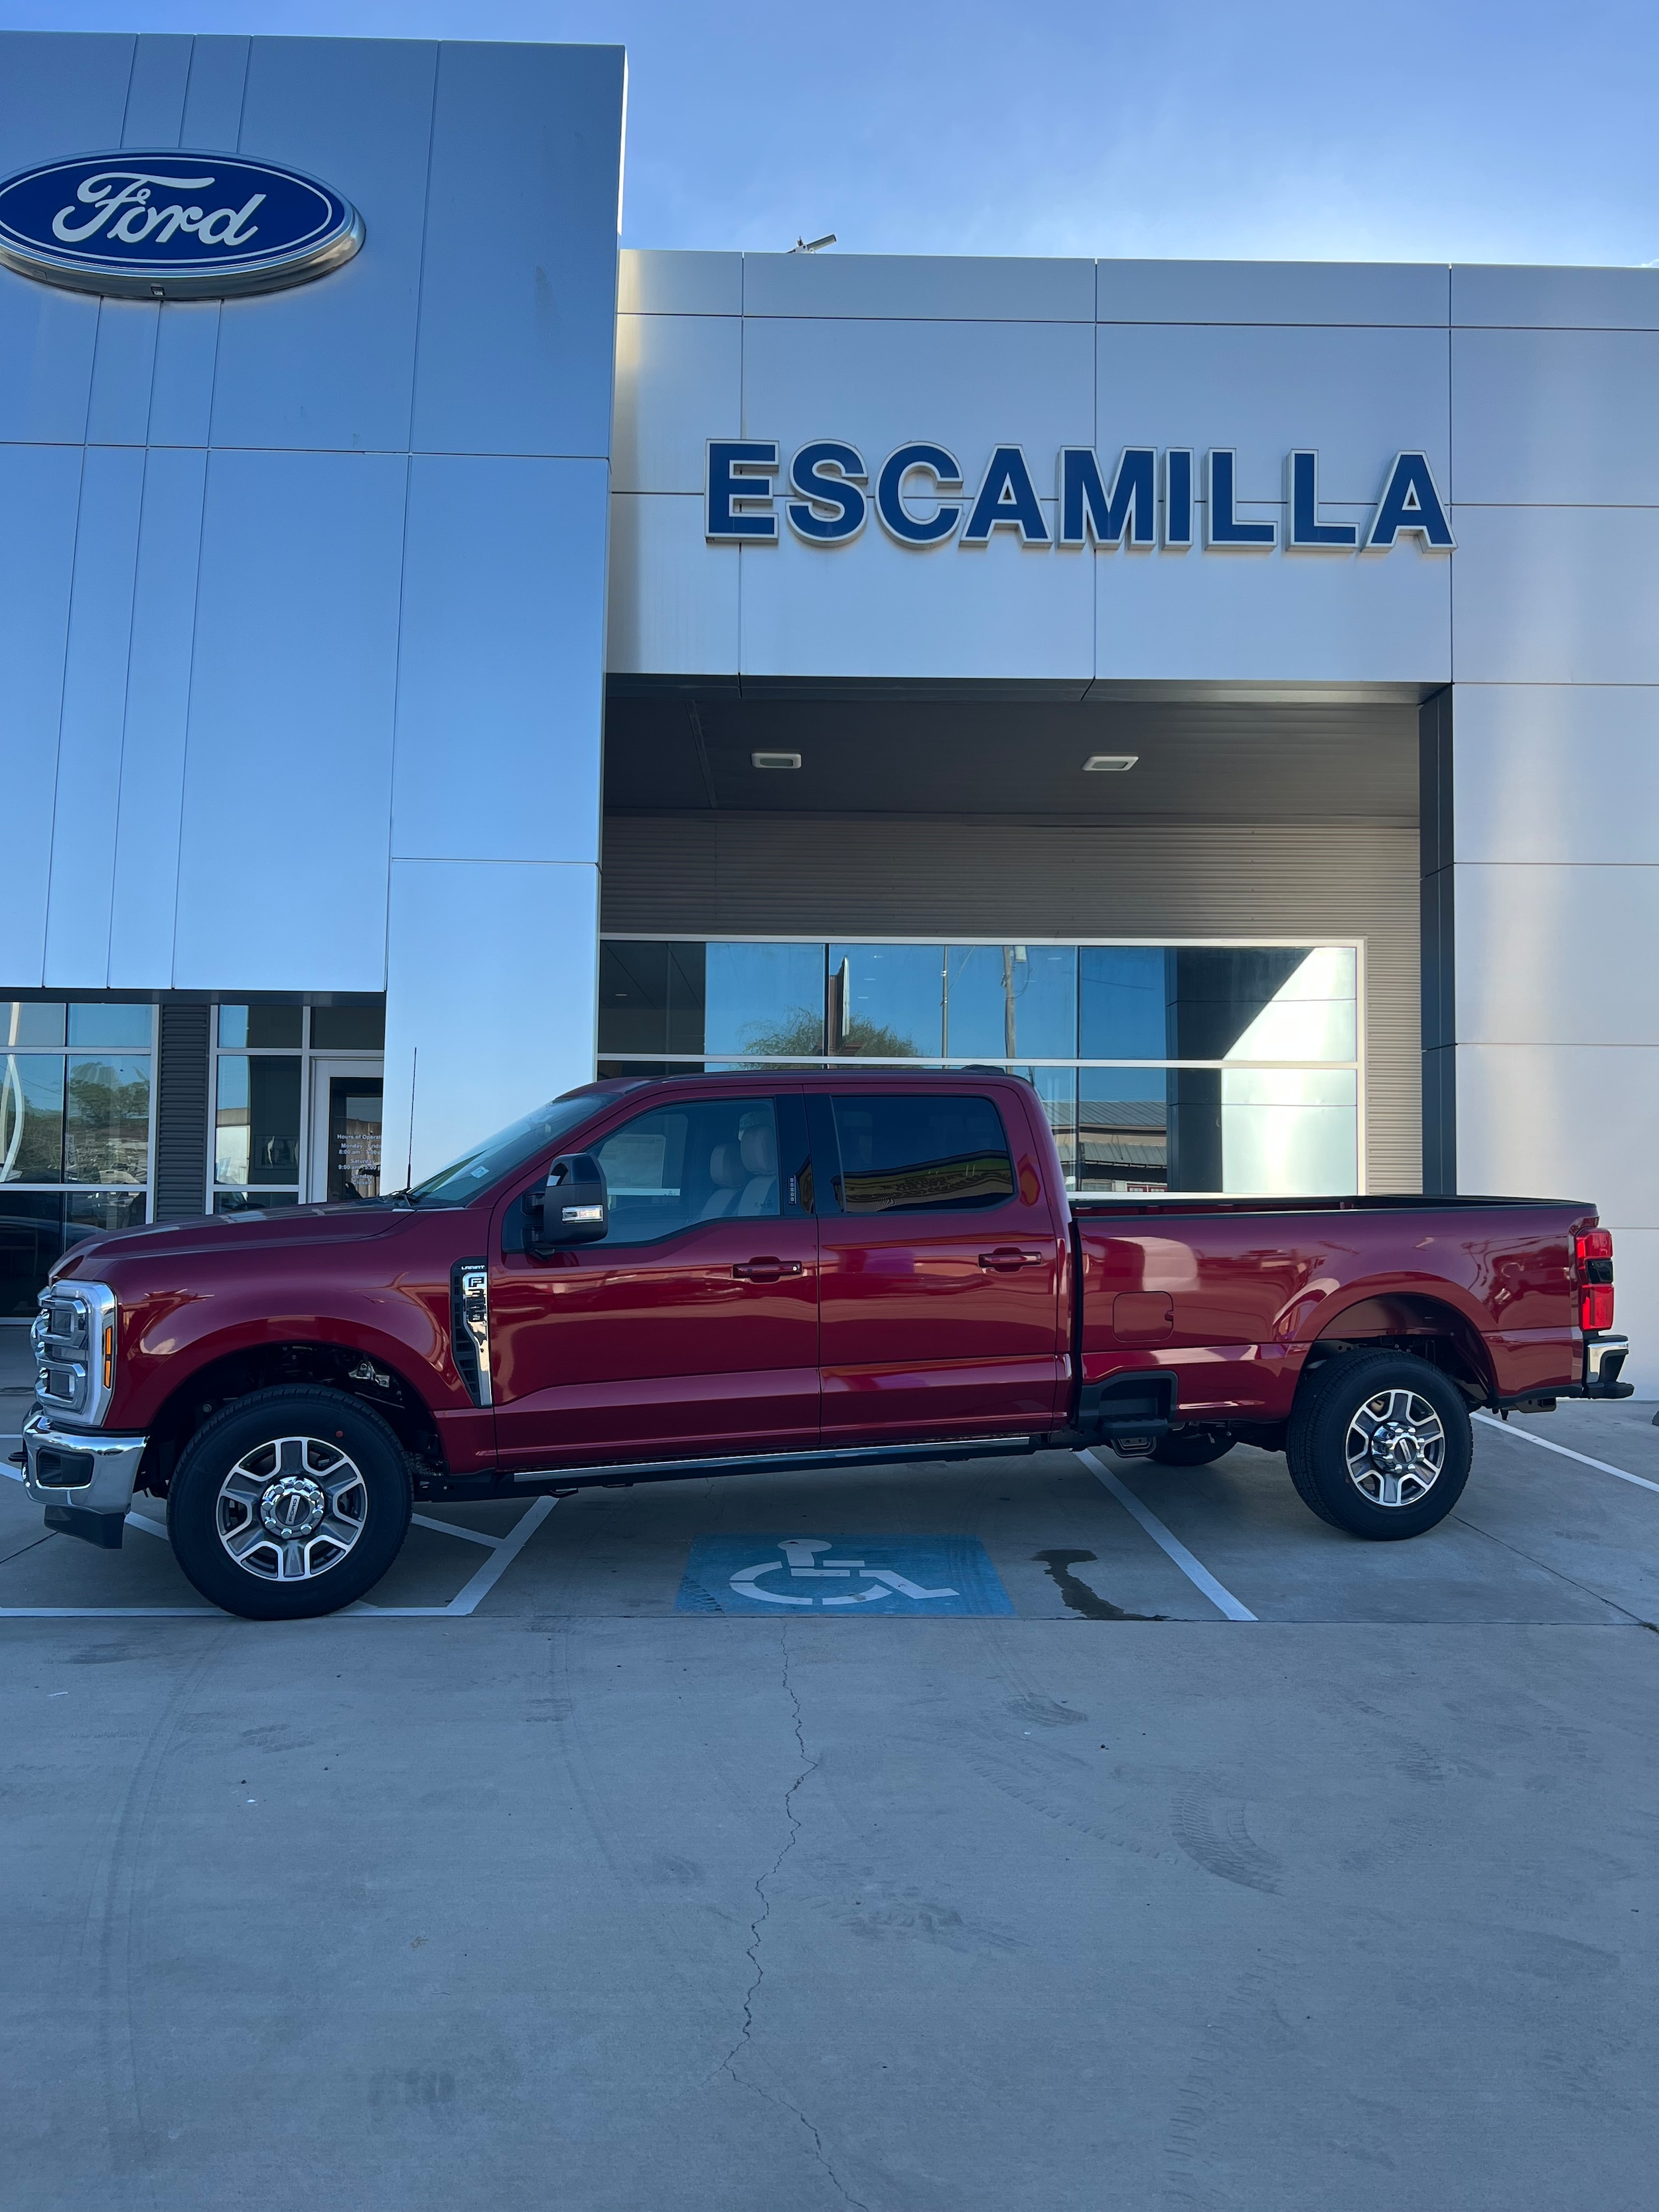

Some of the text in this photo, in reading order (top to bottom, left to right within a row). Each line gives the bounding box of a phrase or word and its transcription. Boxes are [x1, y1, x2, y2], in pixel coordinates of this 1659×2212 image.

[52, 172, 267, 246] Ford
[705, 439, 1455, 552] ESCAMILLA
[289, 1499, 297, 1522] FORD
